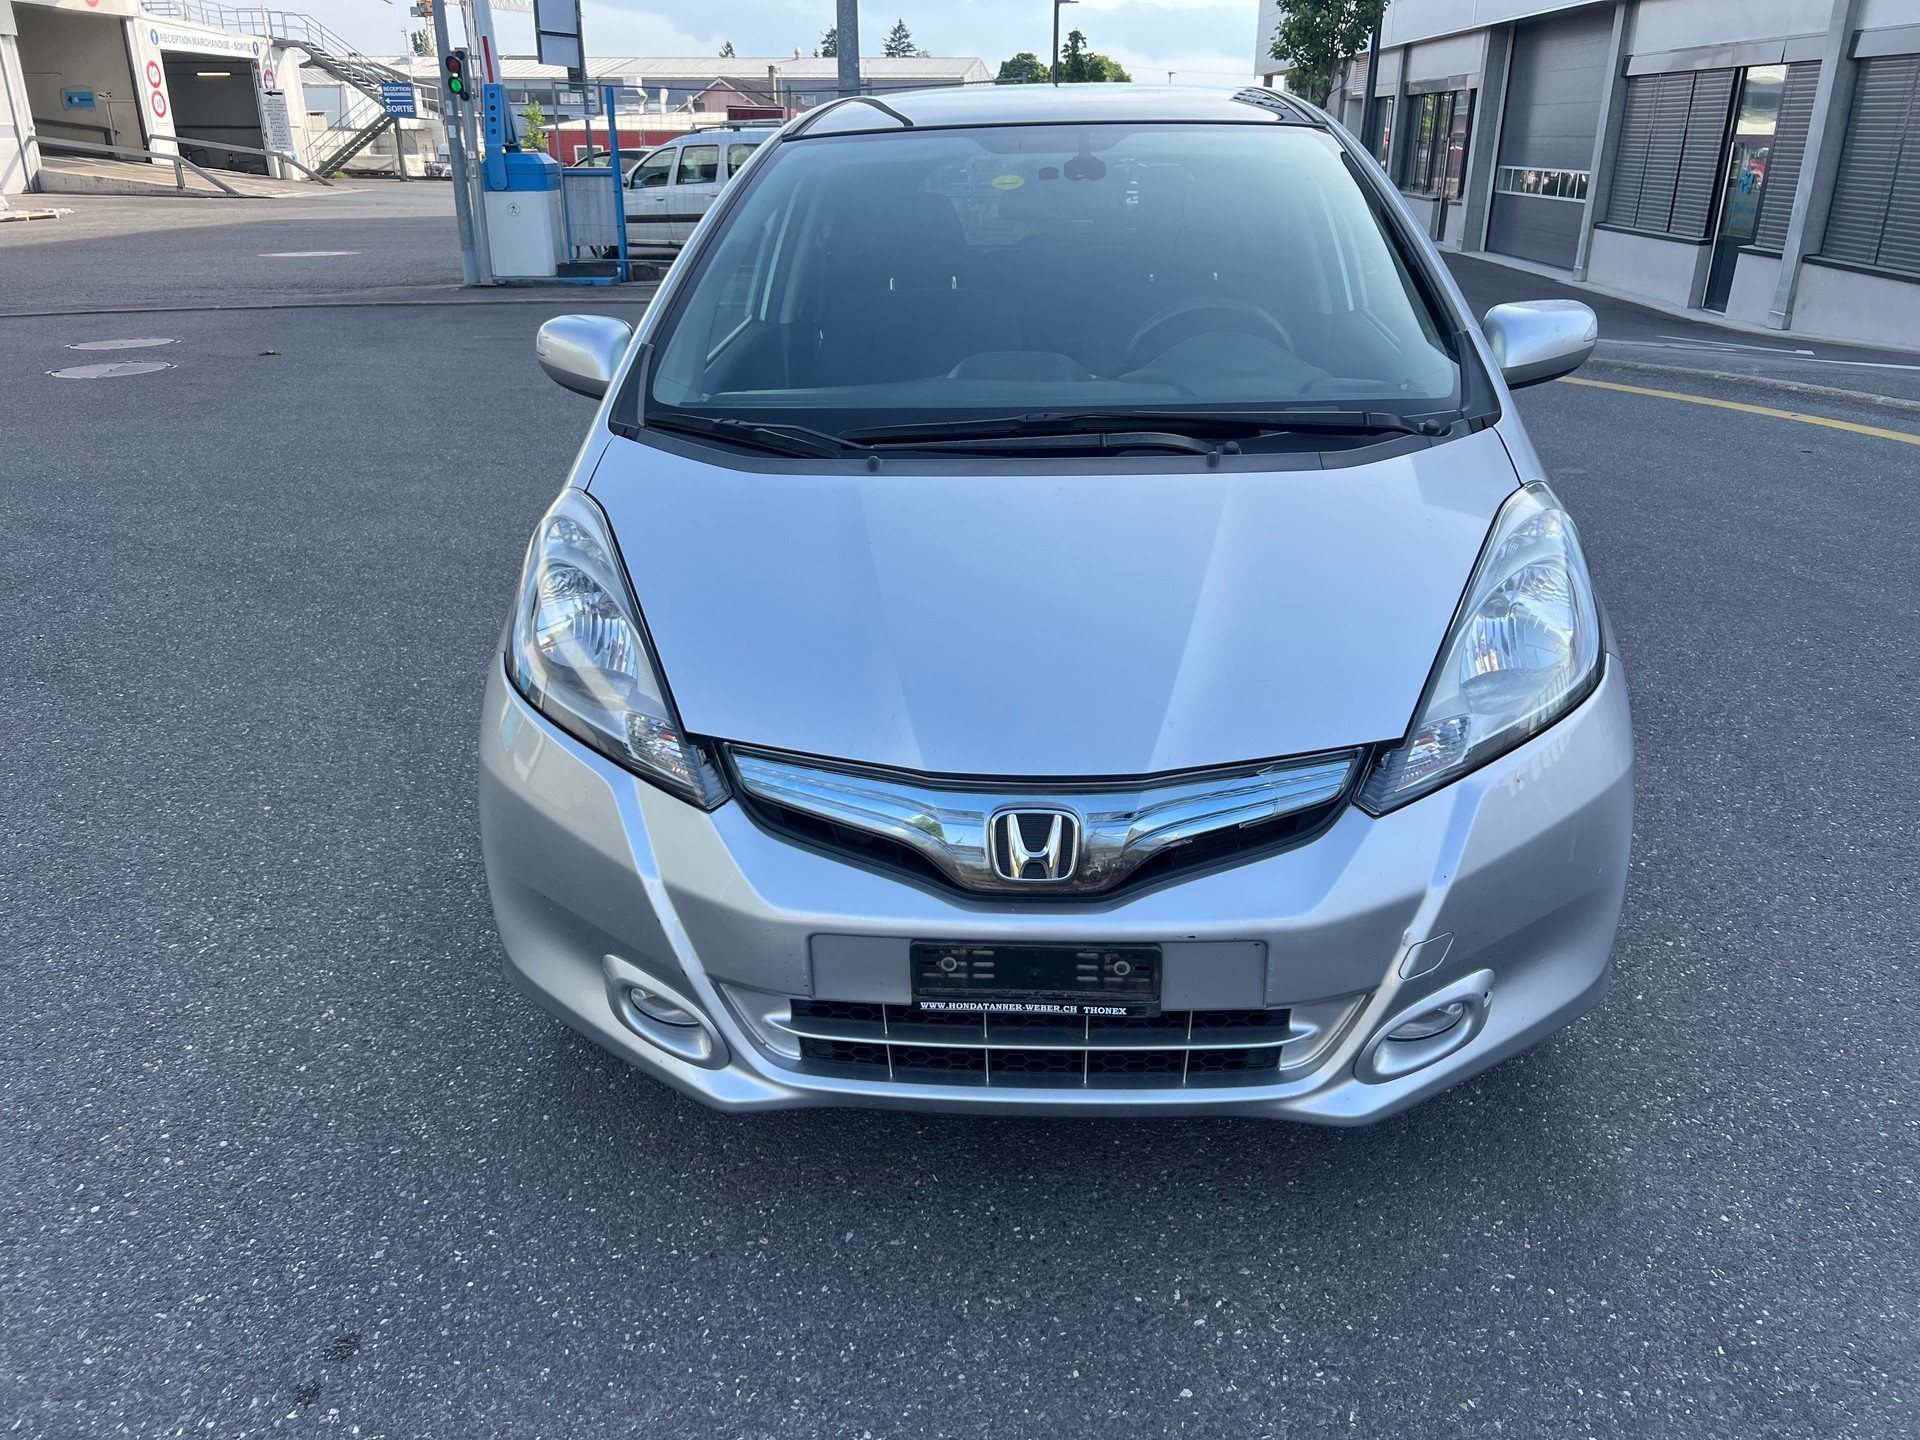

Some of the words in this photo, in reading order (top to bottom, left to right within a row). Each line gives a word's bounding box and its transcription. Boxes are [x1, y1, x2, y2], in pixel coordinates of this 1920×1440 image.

[192, 37, 230, 49] MARCHANDISE
[233, 42, 252, 52] SORTIE
[920, 1002, 1077, 1013] WWW.HONDATANNER-WEBER.CH
[1083, 1006, 1127, 1015] THONEX
